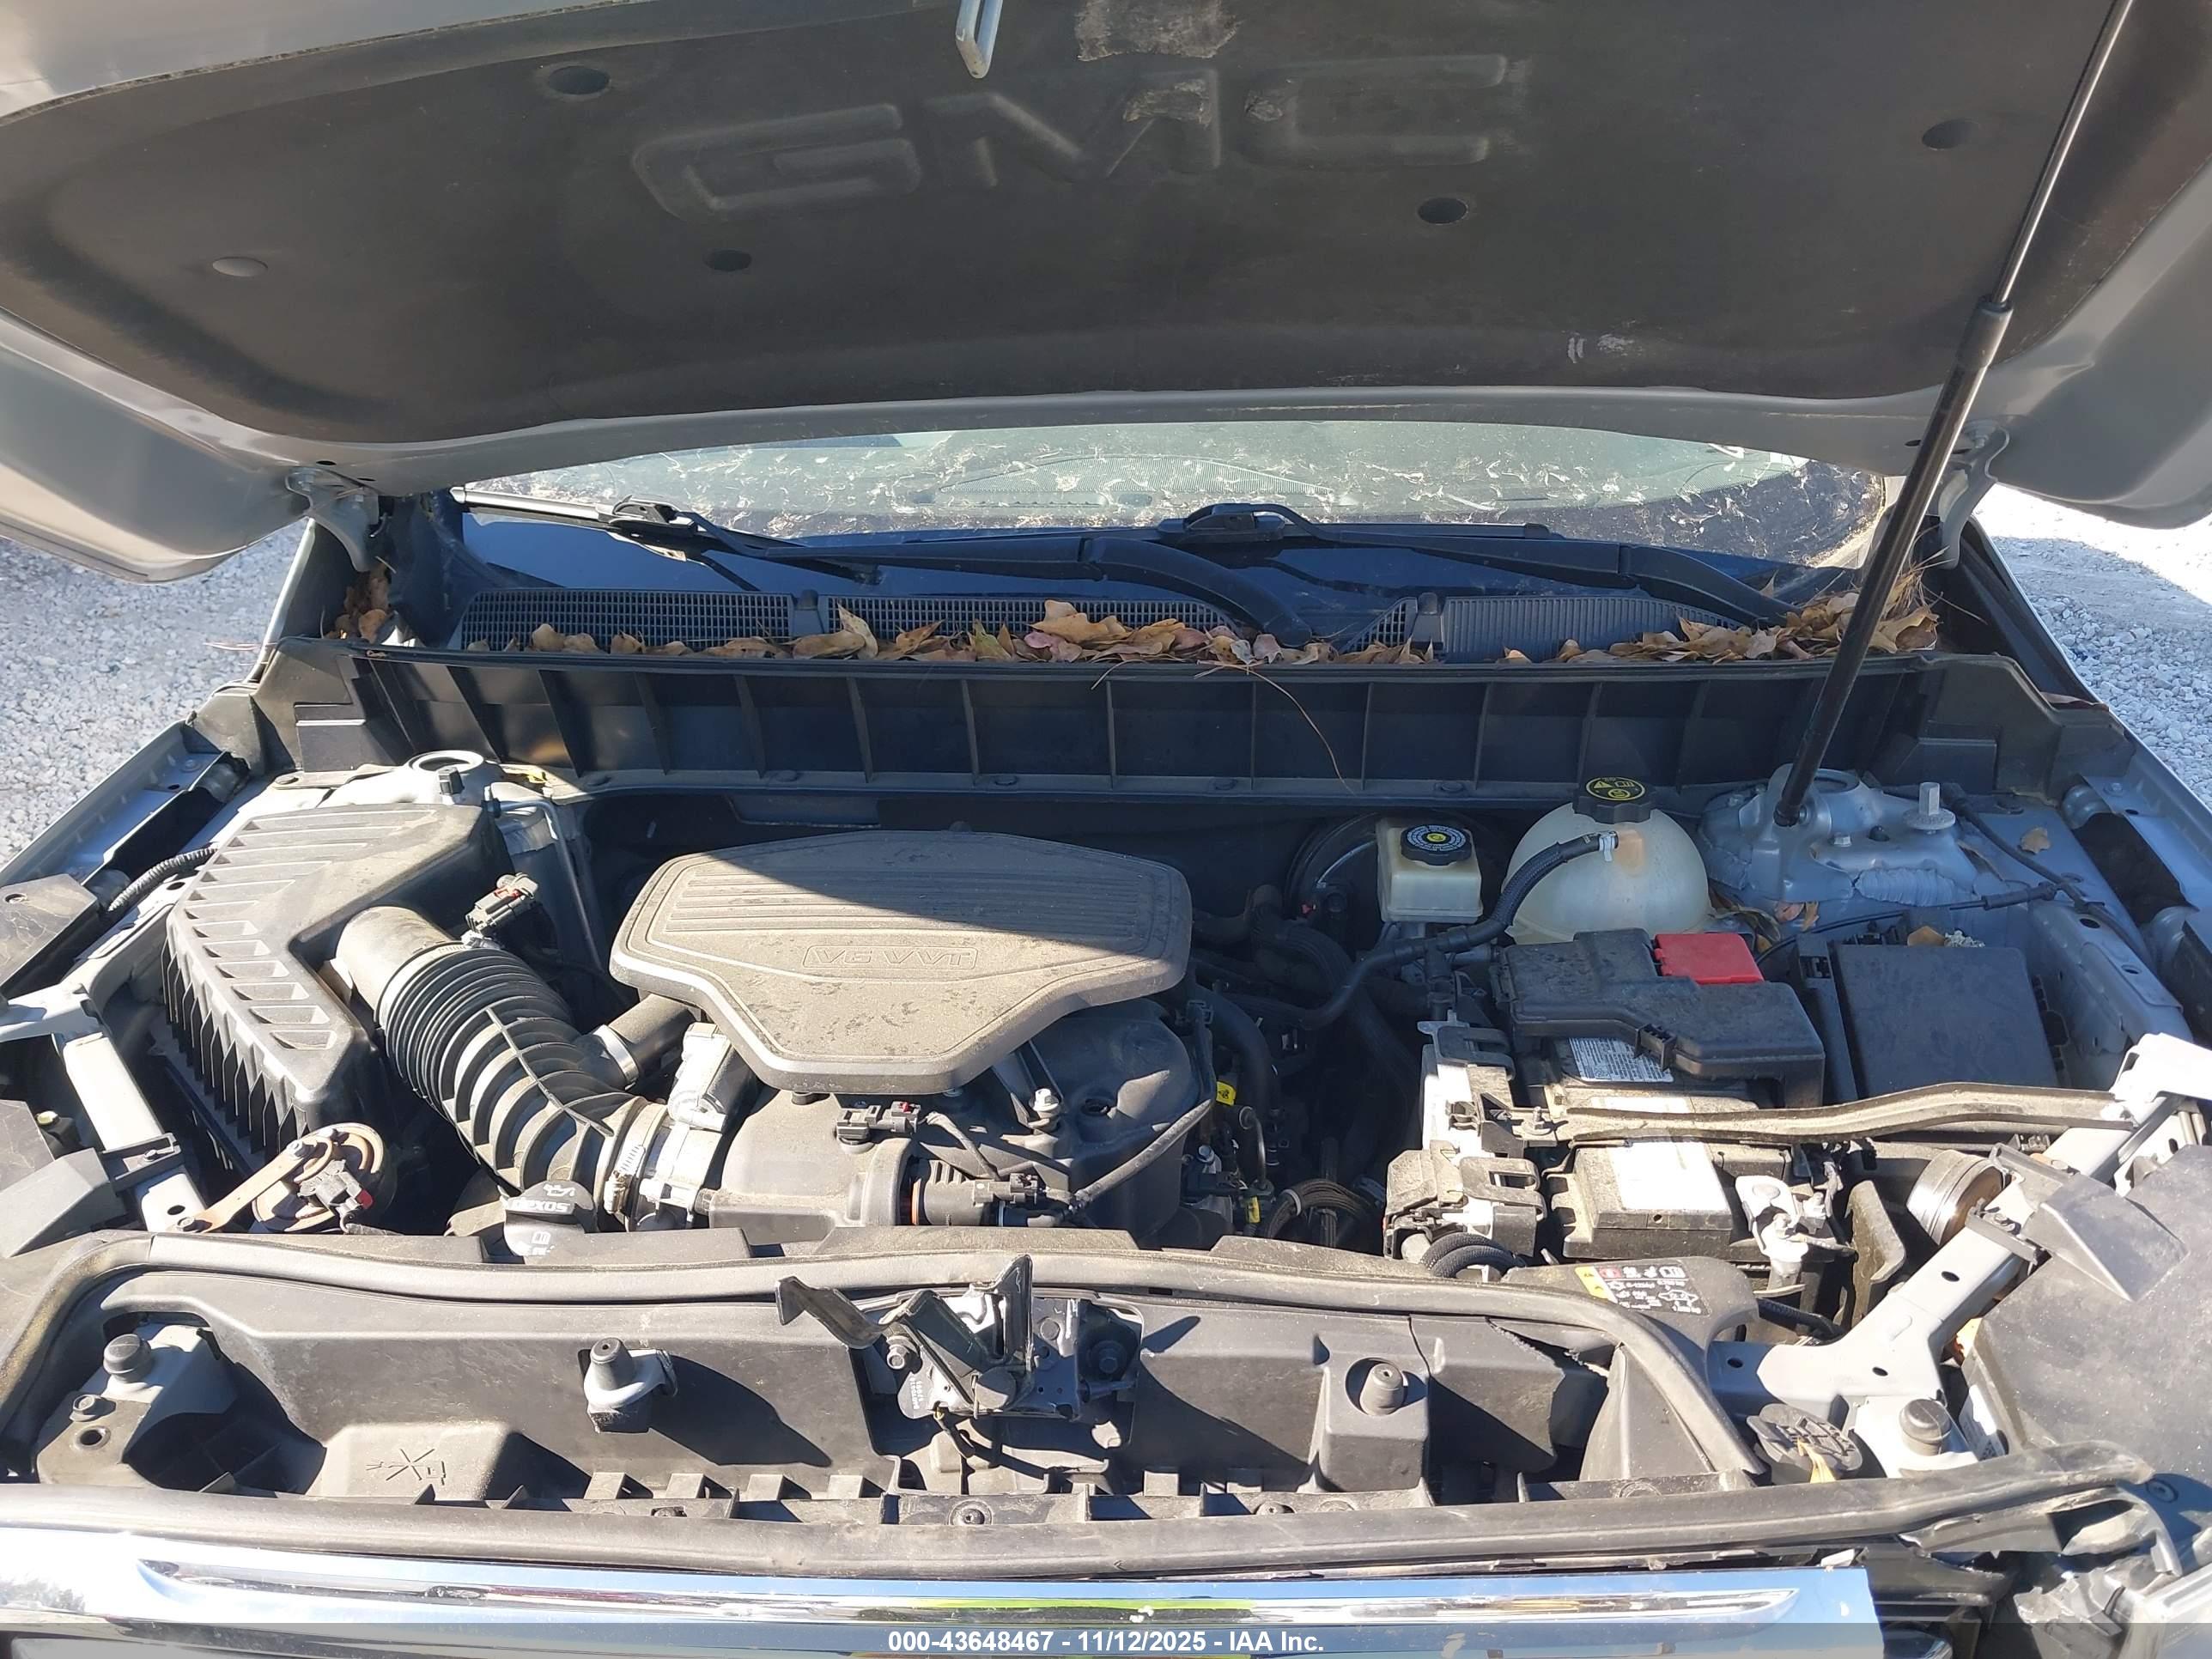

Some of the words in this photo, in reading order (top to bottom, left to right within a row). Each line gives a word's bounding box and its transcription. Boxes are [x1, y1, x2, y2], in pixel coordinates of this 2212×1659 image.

[633, 53, 1513, 220] GMC
[815, 950, 872, 964] V6
[884, 950, 970, 966] VVT
[513, 1196, 570, 1212] dexos
